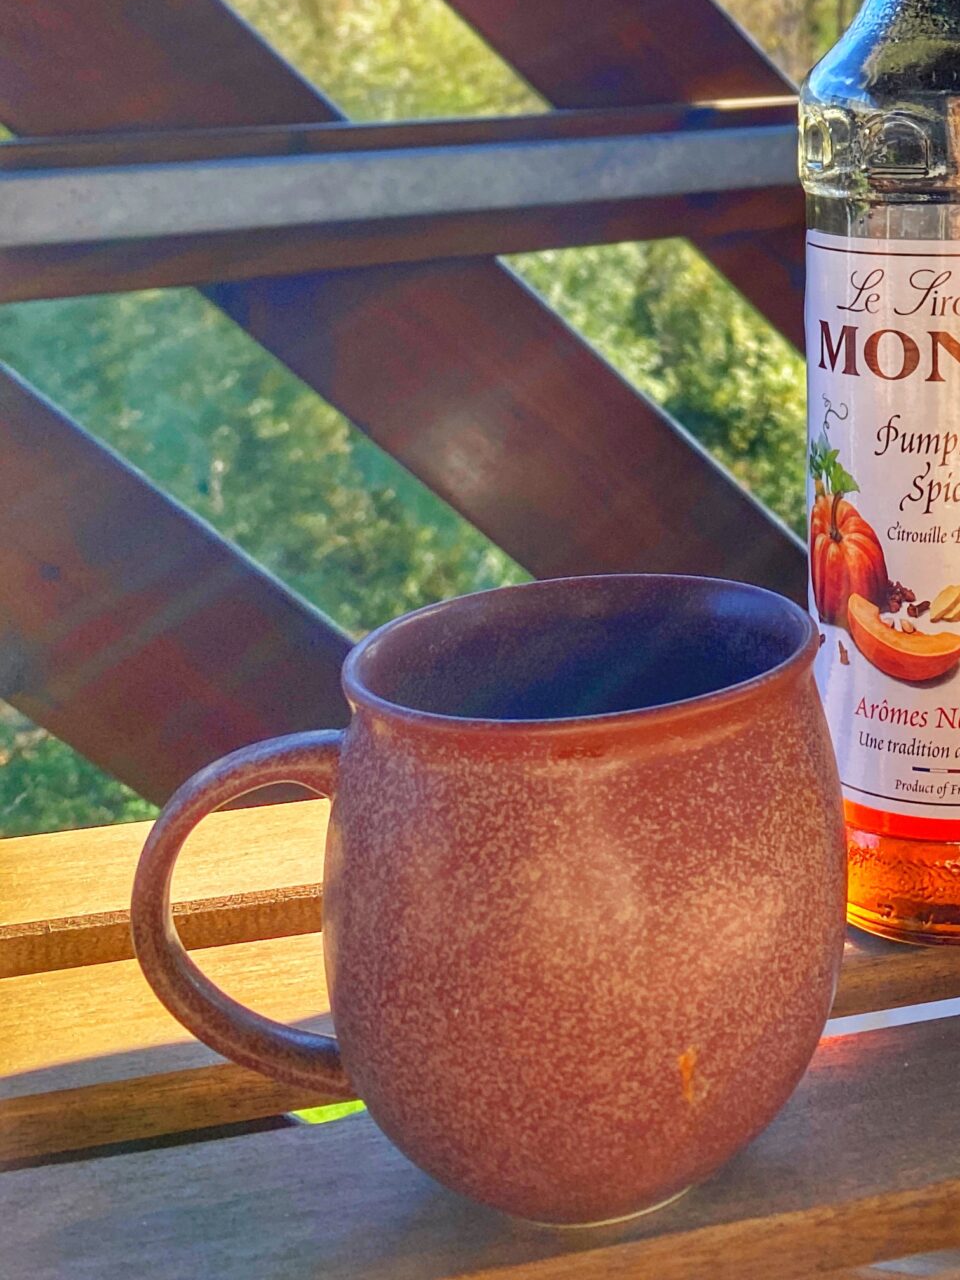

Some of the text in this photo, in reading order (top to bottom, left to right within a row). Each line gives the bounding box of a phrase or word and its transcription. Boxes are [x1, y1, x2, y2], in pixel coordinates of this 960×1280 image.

[836, 268, 885, 314] Le
[887, 521, 948, 544] Citrouille
[854, 696, 929, 729] Arômes
[859, 731, 884, 751] Une
[887, 737, 950, 759] tradition
[895, 779, 934, 795] Product
[936, 781, 950, 799] of
